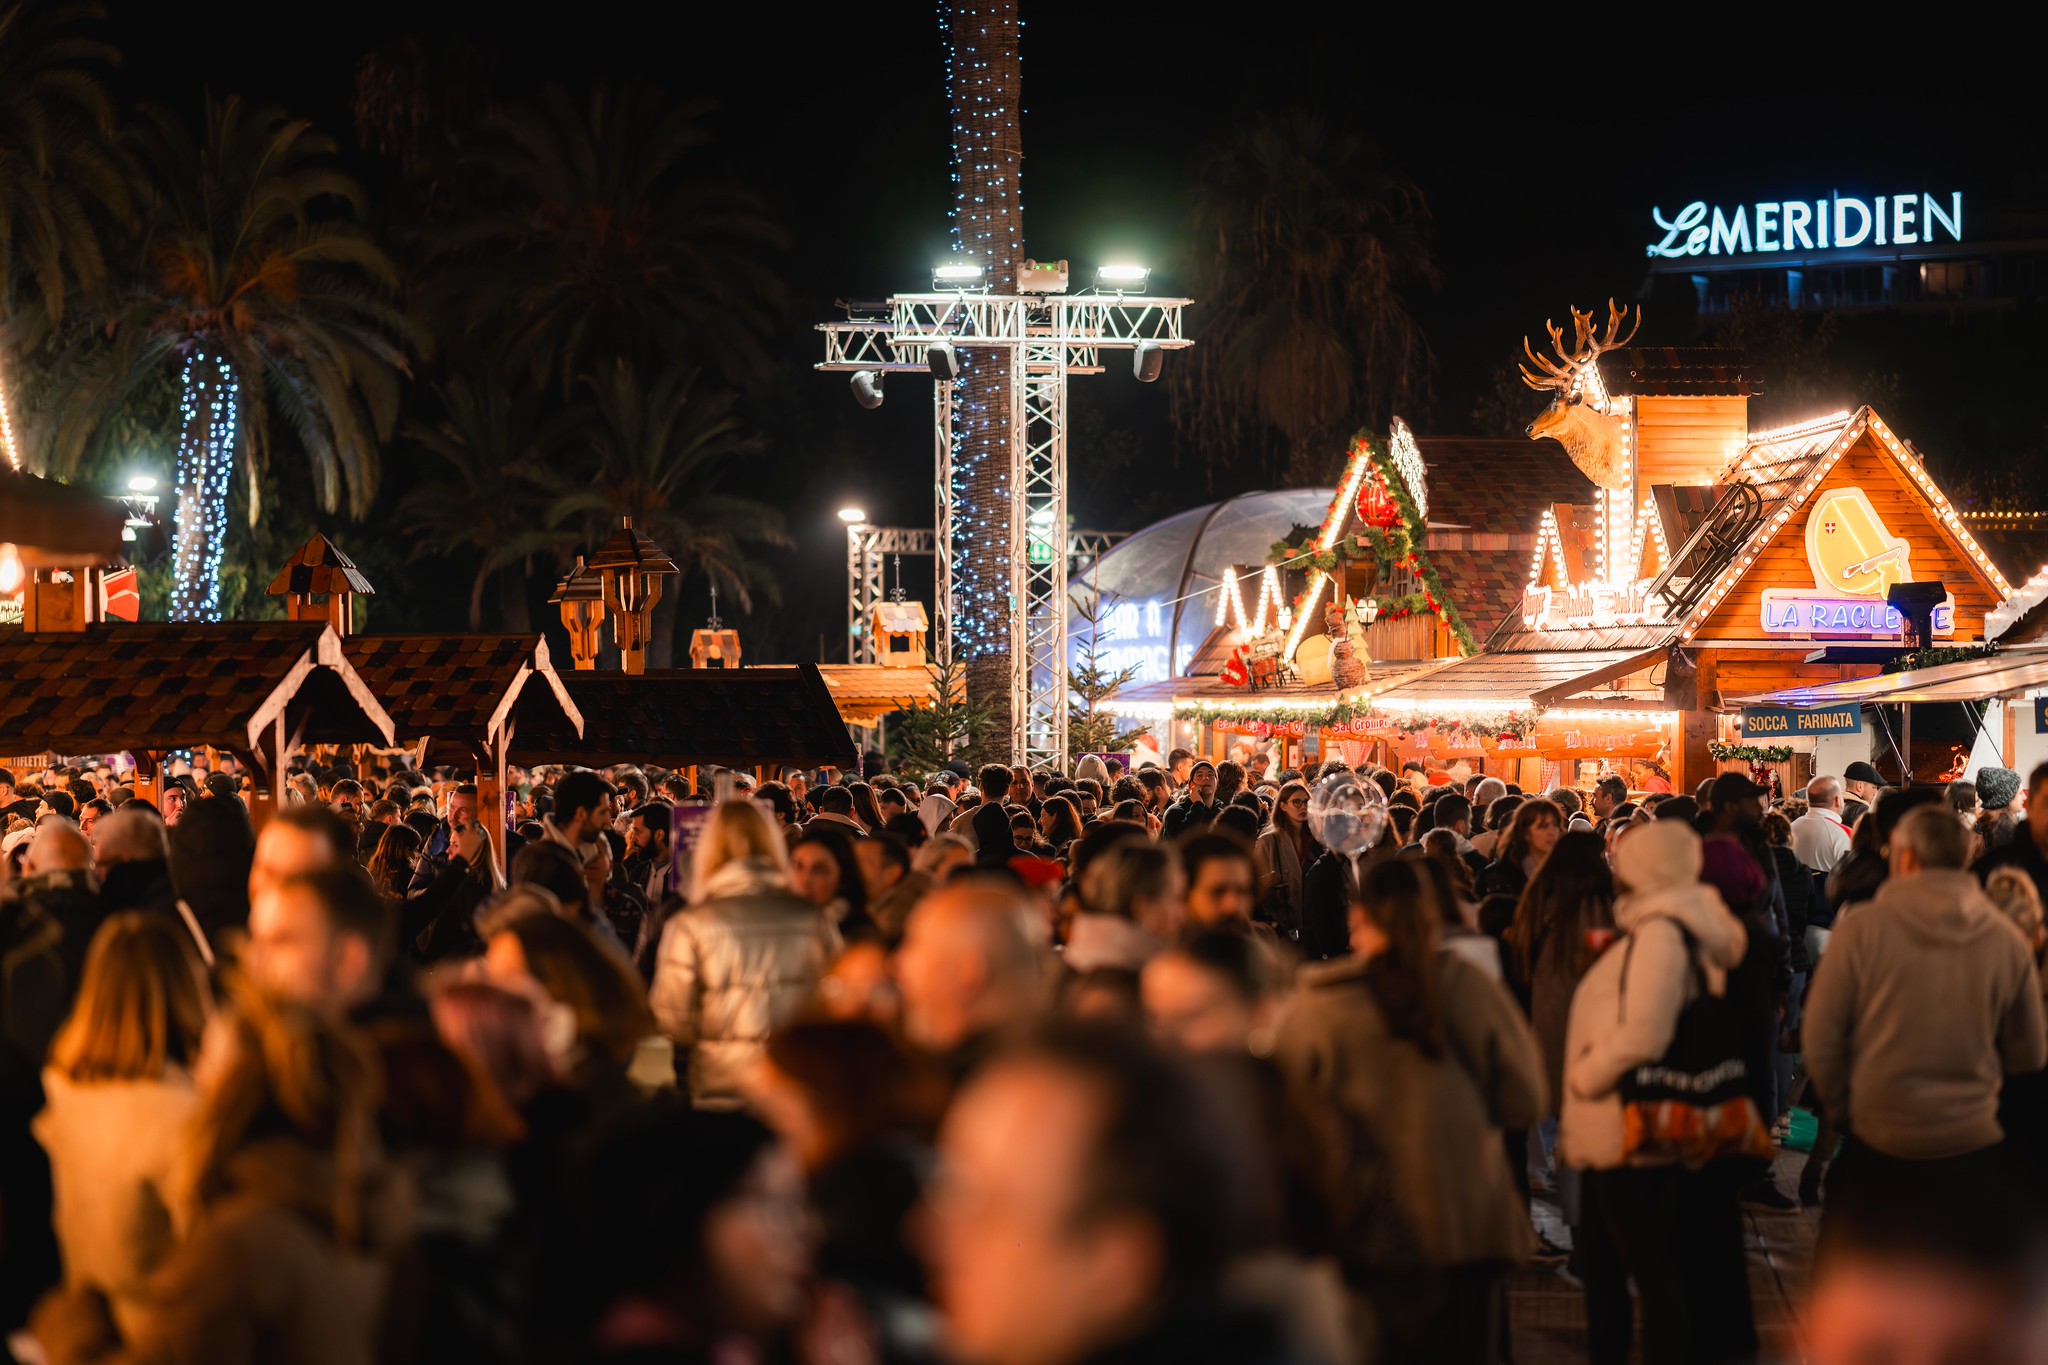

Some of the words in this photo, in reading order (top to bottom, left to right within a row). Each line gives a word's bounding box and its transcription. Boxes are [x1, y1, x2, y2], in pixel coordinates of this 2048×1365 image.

[1766, 603, 1798, 628] LA
[1811, 604, 1951, 630] RACLEE
[1748, 714, 1788, 732] SOCCA
[1797, 712, 1854, 730] FARINATA
[1563, 730, 1637, 752] Burger
